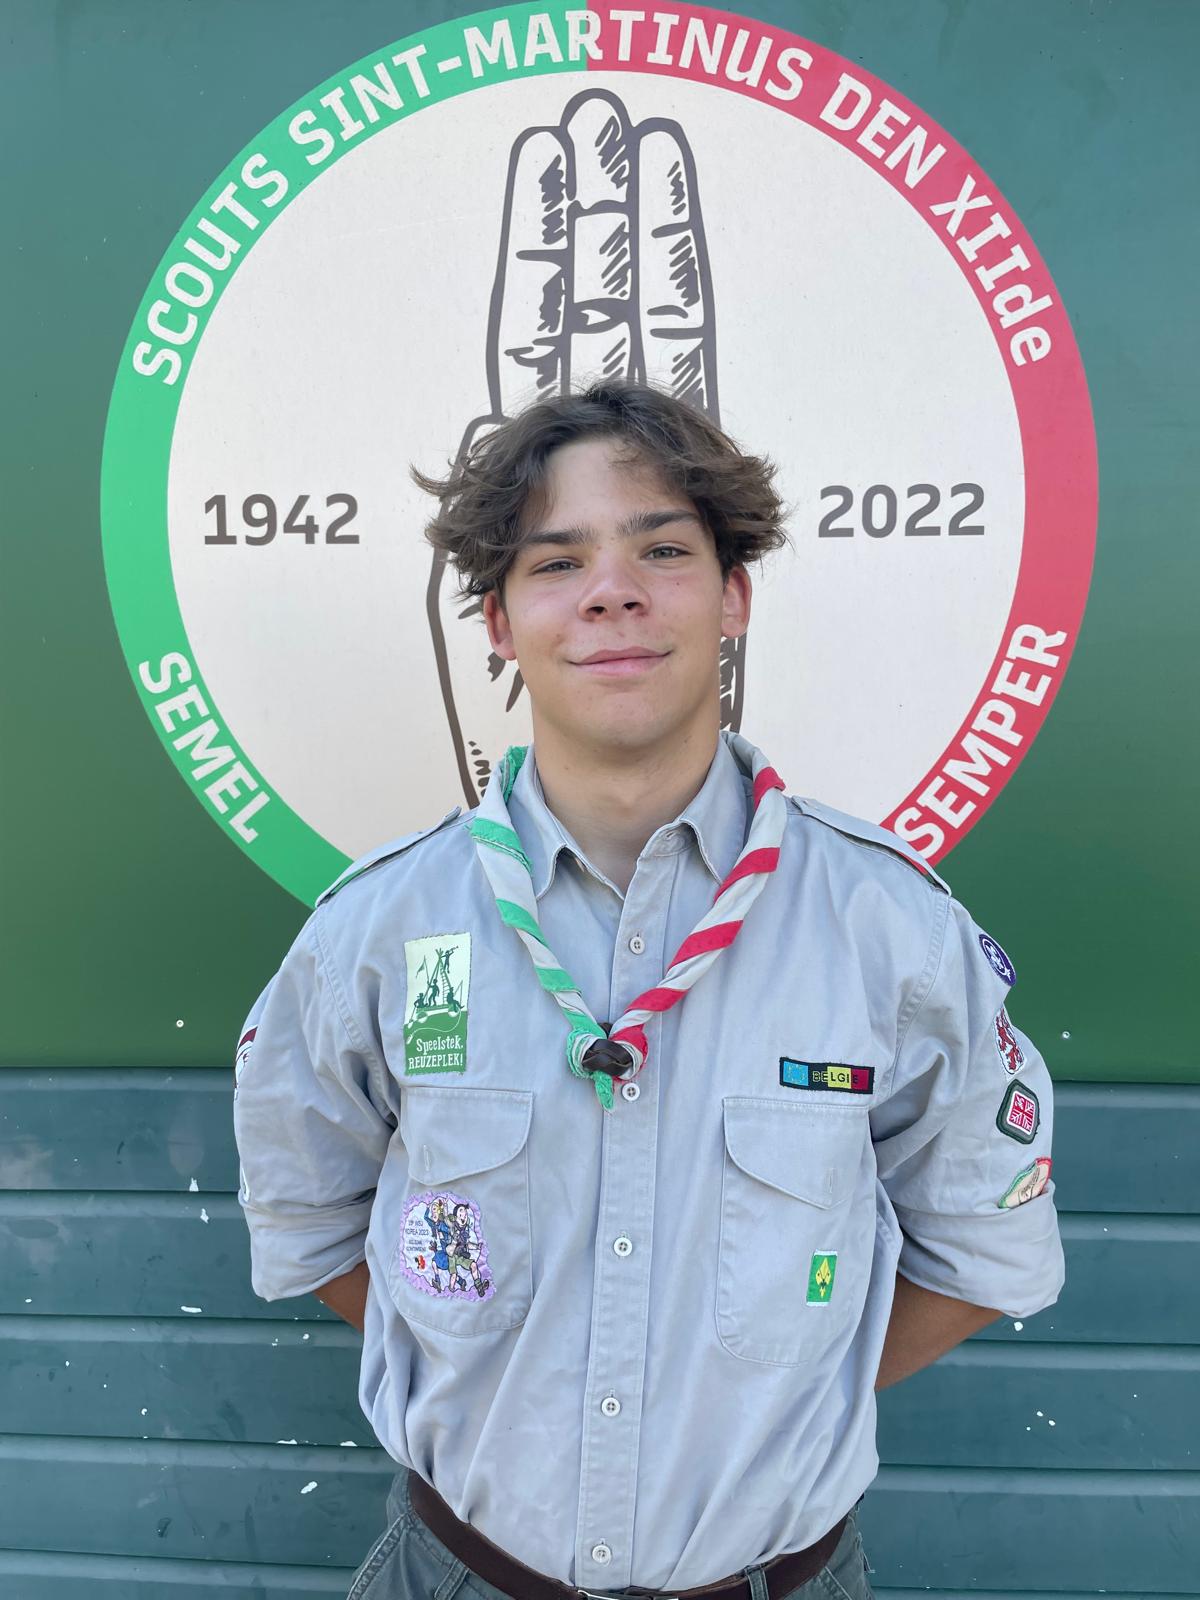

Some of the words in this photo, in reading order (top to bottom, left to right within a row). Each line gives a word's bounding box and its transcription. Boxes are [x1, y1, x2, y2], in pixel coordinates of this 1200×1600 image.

[132, 153, 289, 386] SCOUTS
[288, 9, 813, 166] SINT-MARTINUS
[819, 72, 946, 190] DEN
[929, 173, 1053, 367] XIIde
[204, 493, 360, 546] 1942
[818, 482, 985, 538] 2022
[138, 651, 270, 844] SEMEL
[894, 623, 1067, 860] SEMPER
